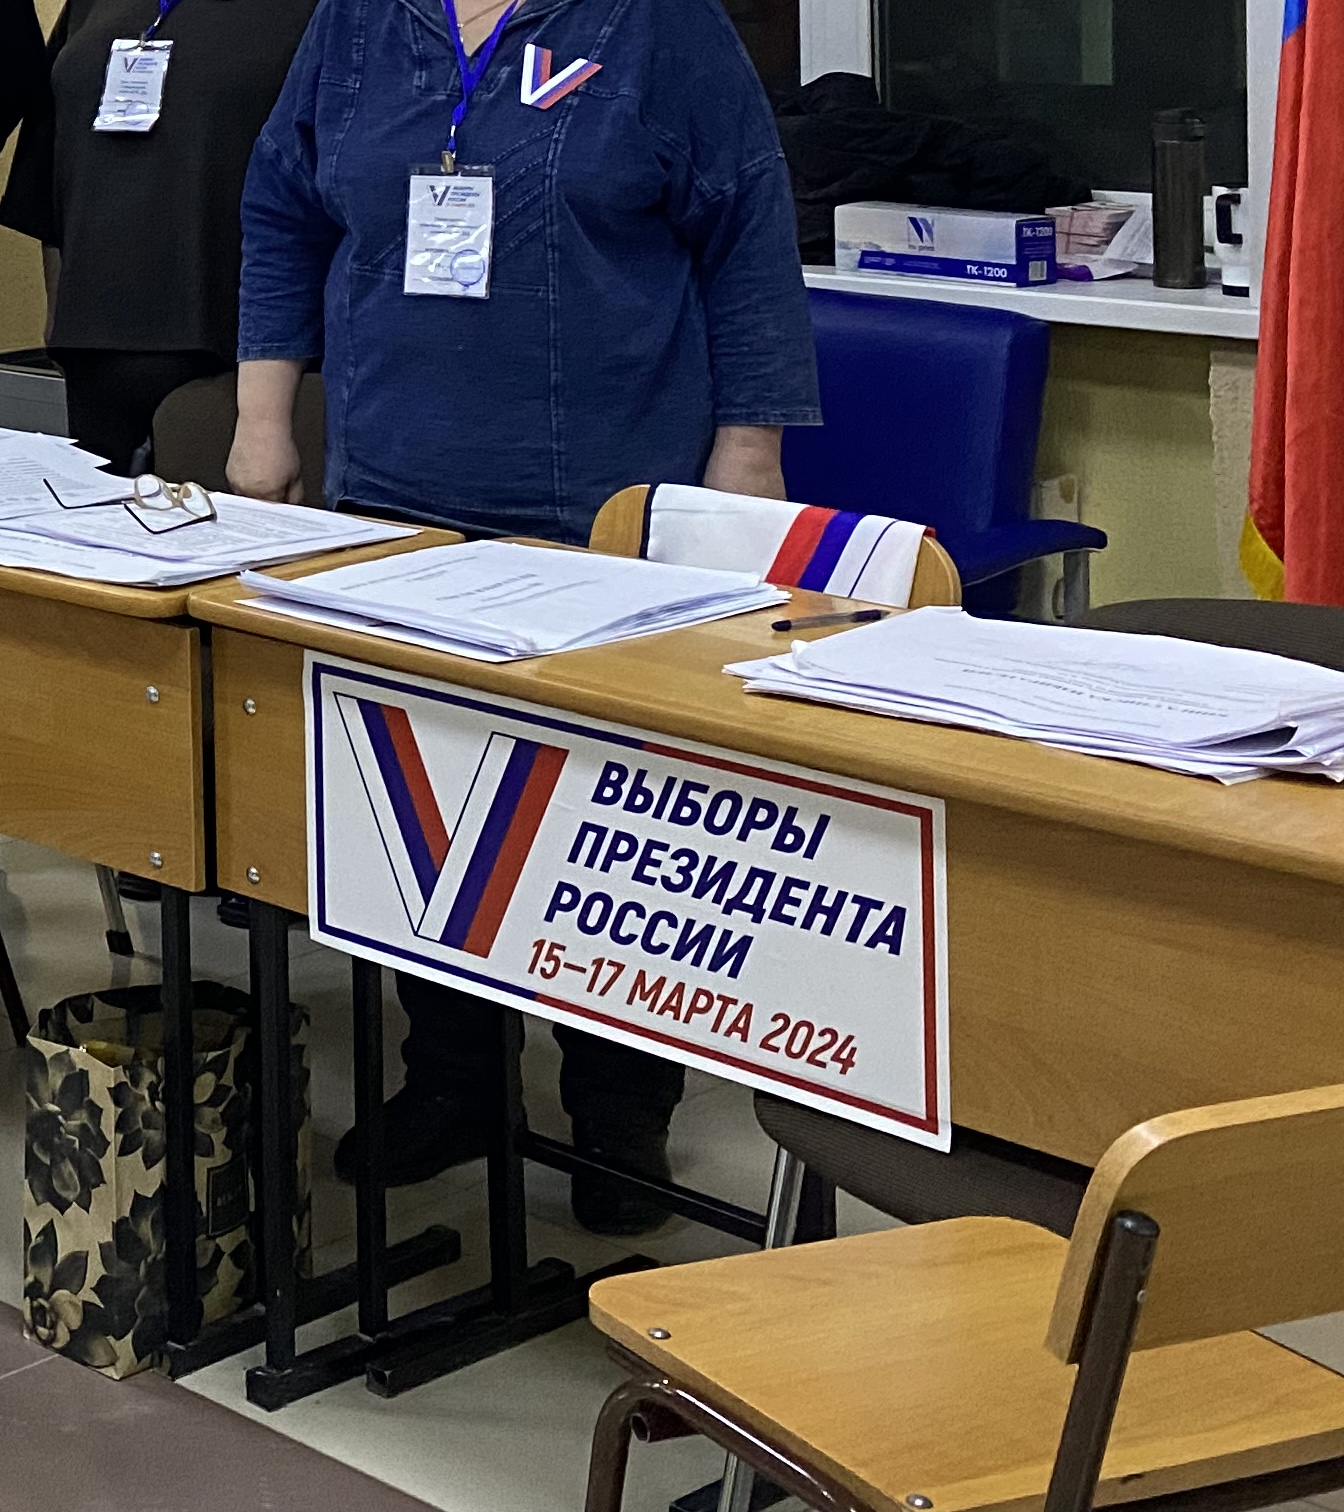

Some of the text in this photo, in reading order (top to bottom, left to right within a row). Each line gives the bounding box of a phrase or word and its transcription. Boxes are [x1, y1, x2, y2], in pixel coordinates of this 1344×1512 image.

[966, 264, 1007, 278] TK-1200
[590, 759, 832, 860] ВЫБОРЫ
[543, 880, 754, 980] РОССИИ
[565, 819, 909, 958] ПРЕЗИДЕНТА
[625, 967, 753, 1044] МАРТА
[759, 1012, 858, 1076] 2024
